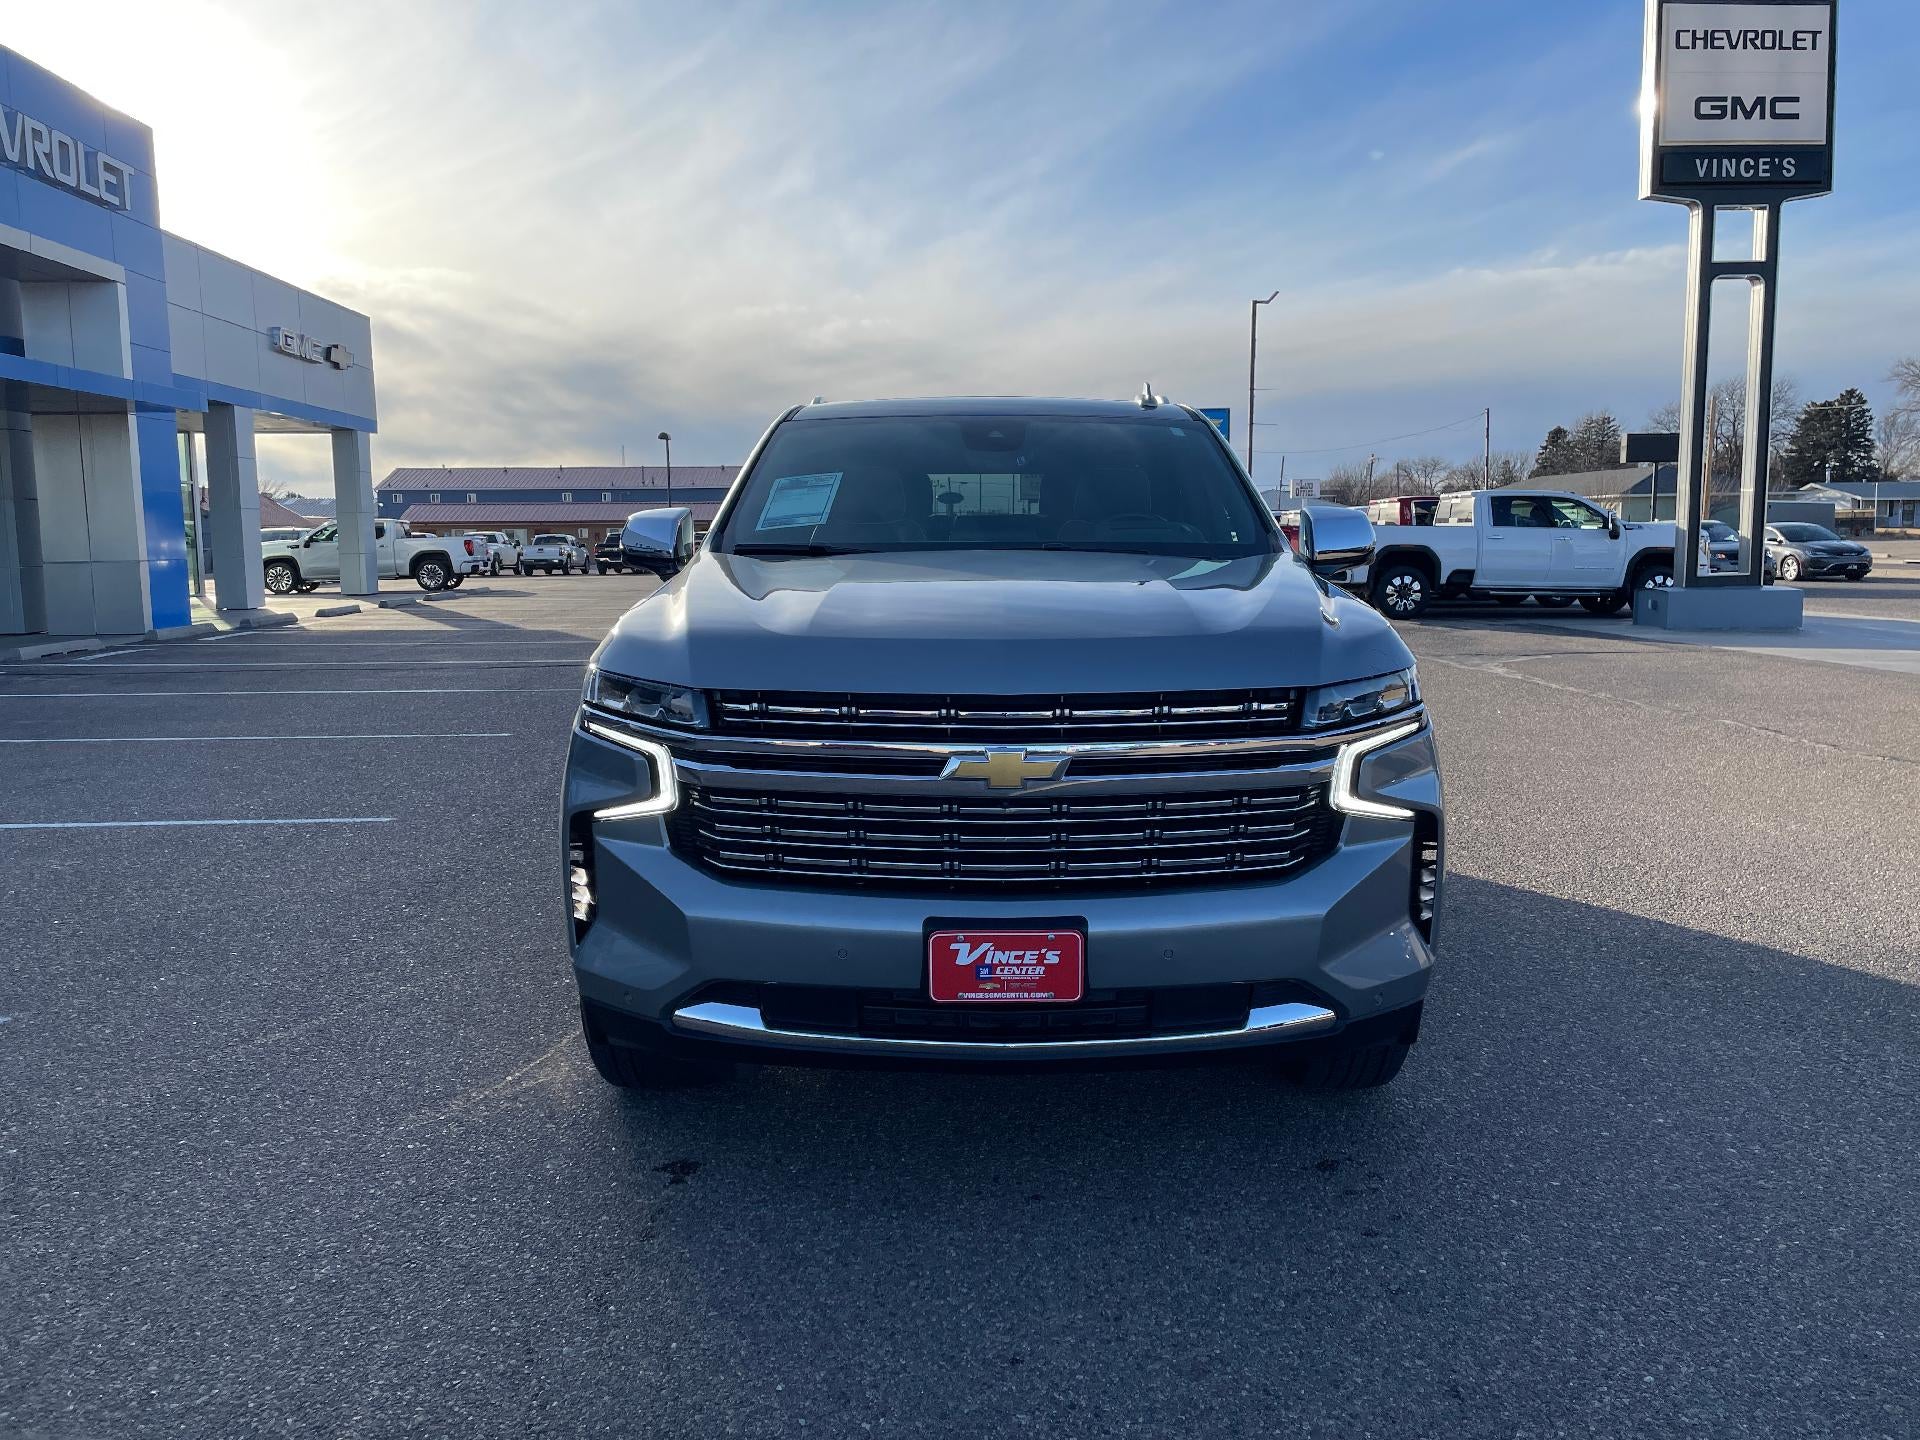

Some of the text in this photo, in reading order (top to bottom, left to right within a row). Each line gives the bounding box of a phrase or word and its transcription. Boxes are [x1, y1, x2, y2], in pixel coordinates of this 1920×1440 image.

[1675, 29, 1822, 50] CHEVROLET
[1694, 96, 1800, 120] GMC
[1695, 157, 1796, 178] VINCE'S
[277, 326, 324, 364] GMC
[950, 942, 1061, 966] VINCE'S
[995, 966, 1046, 975] CENTER
